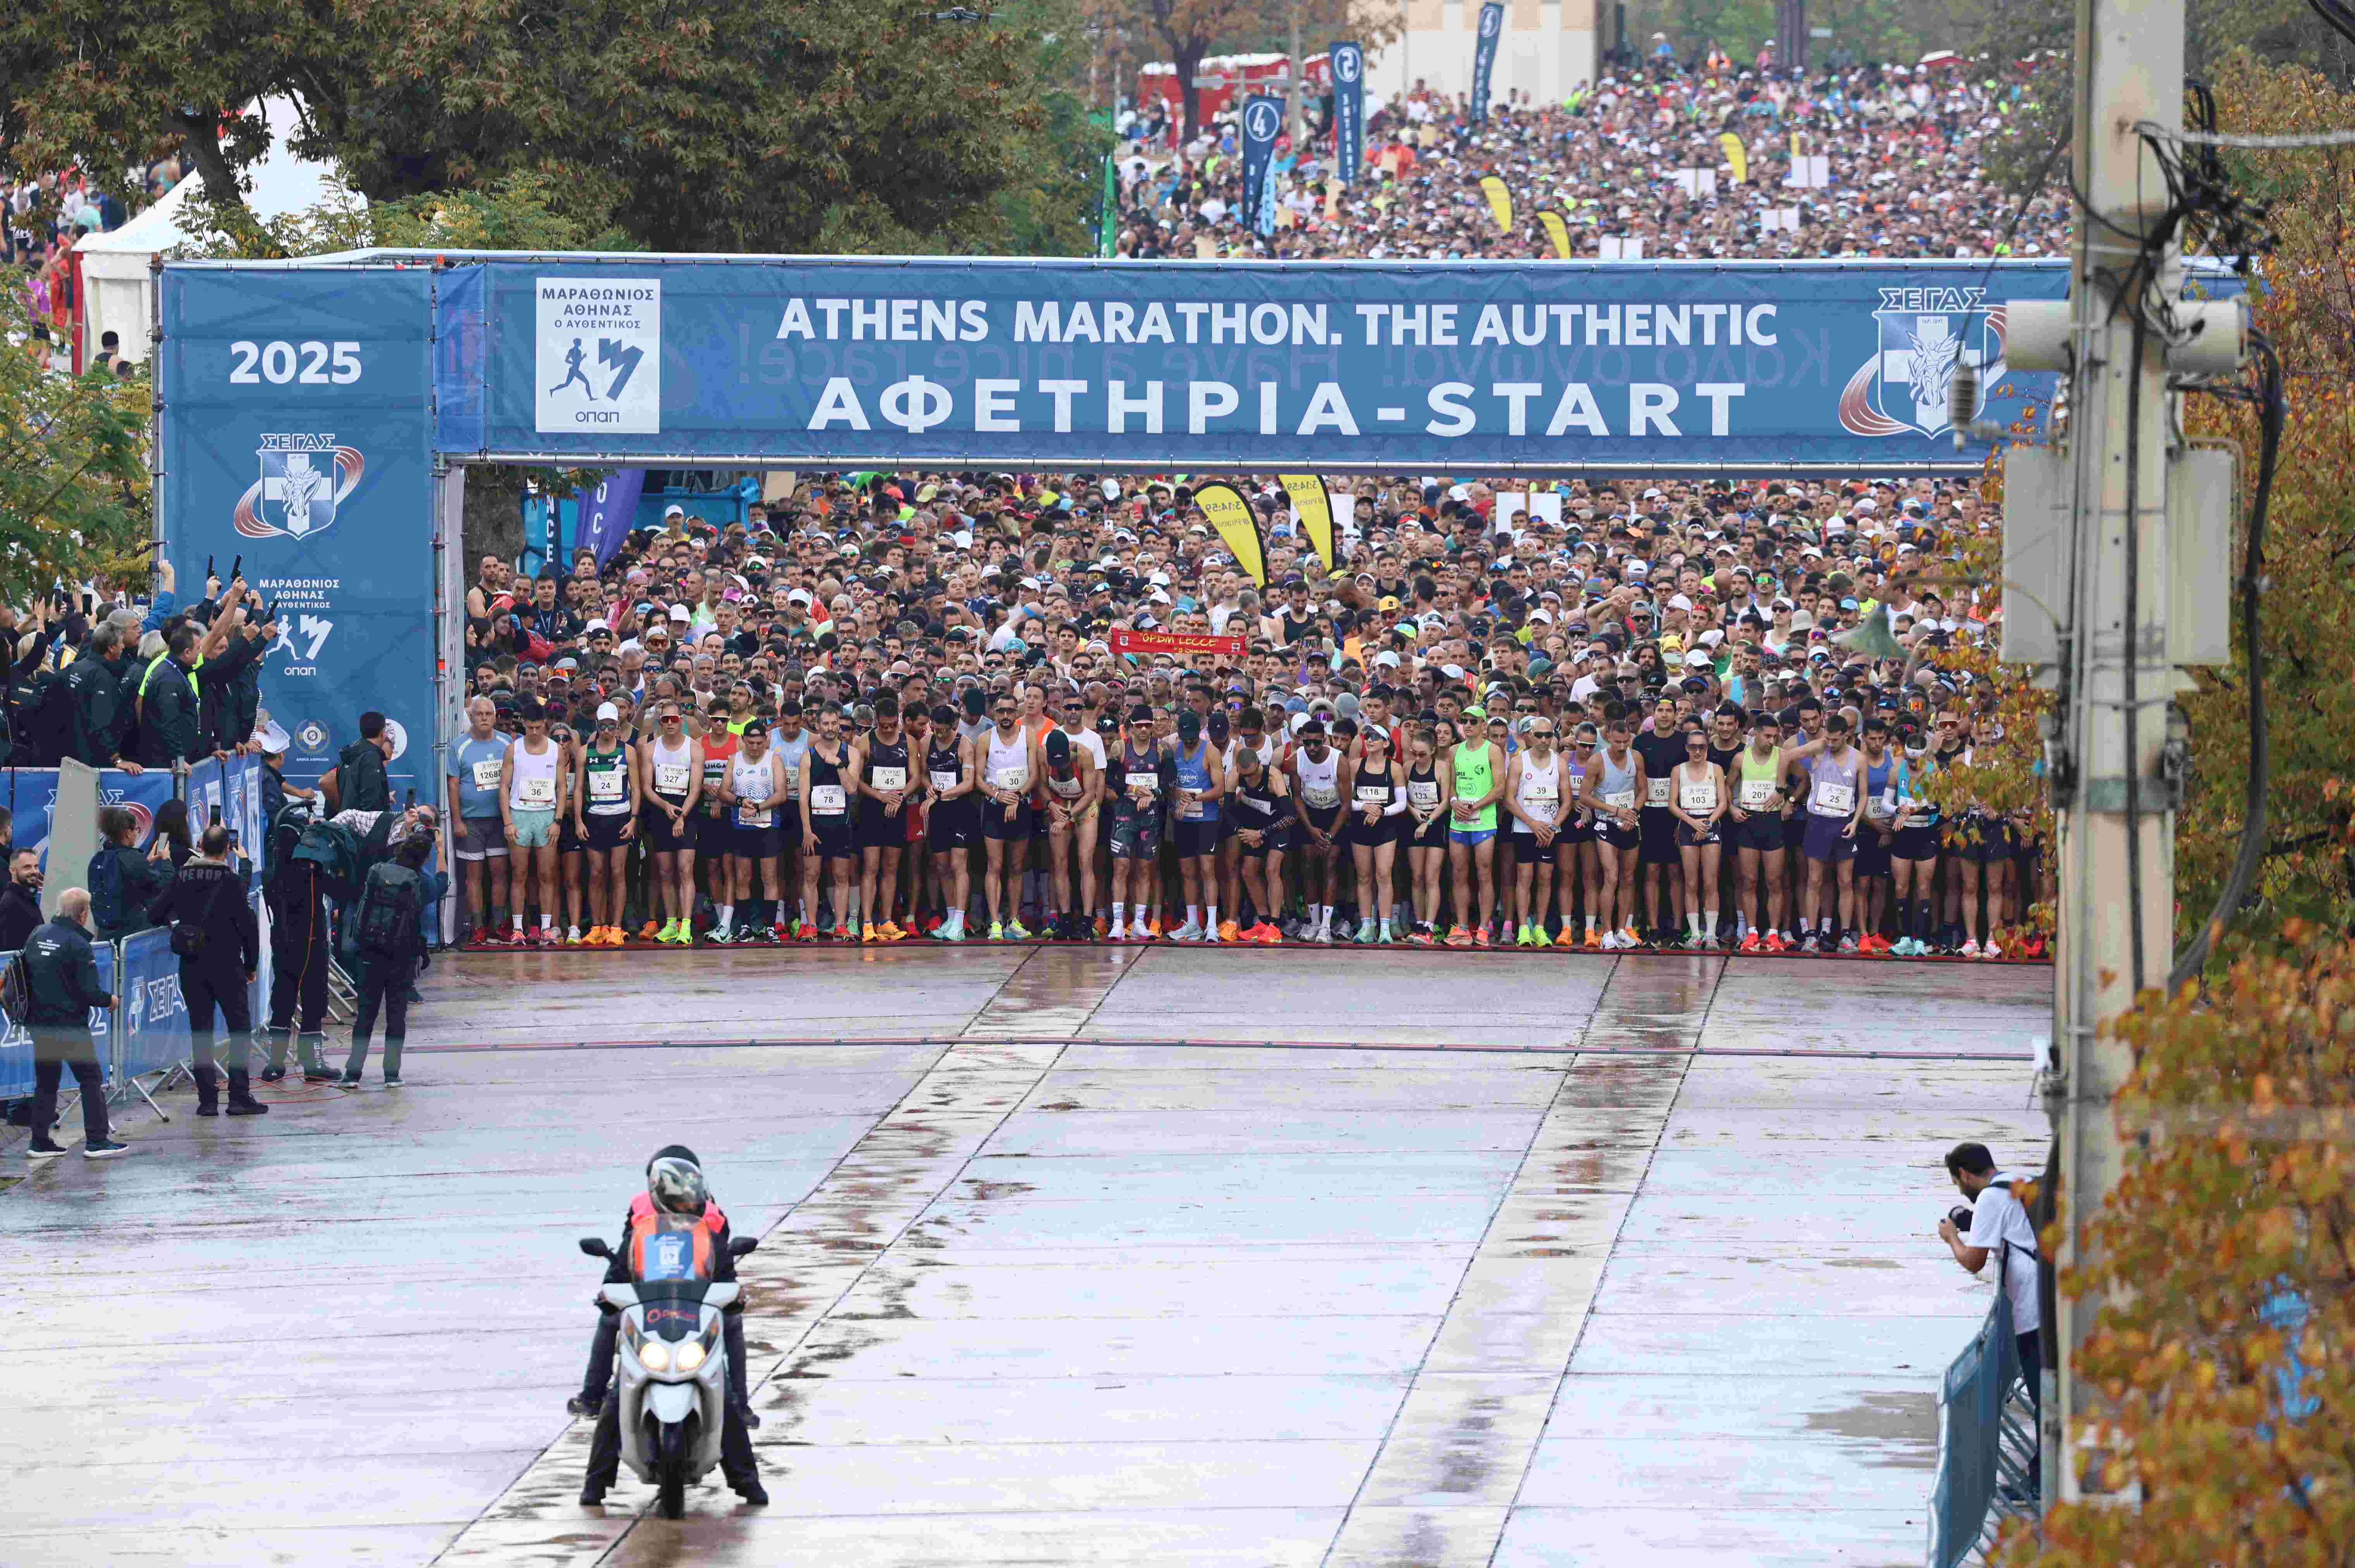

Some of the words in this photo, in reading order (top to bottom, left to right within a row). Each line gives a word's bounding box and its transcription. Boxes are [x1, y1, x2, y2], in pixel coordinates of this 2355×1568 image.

[1252, 105, 1267, 137] 4
[542, 288, 654, 301] ΜΑΡΑΘΩΝΙΟΣ
[1878, 287, 1986, 310] ΣΕΓΑΣ
[564, 304, 632, 316] ΑΘΗΝΑΣ
[555, 320, 562, 328] Ο
[567, 320, 641, 328] ΑΥΘΕΝΤΙΚΟΣ
[776, 298, 988, 342] ATHENS
[1013, 301, 1342, 345] MARATHON.
[1356, 304, 1459, 345] THE
[1471, 304, 1777, 346] AUTHENTIC
[230, 341, 362, 384] 2025
[260, 433, 335, 450] ΣΕΓΑΣ
[259, 579, 339, 588] ΜΑΡΑΘΩΝΙΟΣ
[275, 591, 324, 599] ΑΘΗΝΑΣ
[1830, 795, 1840, 803] 25
